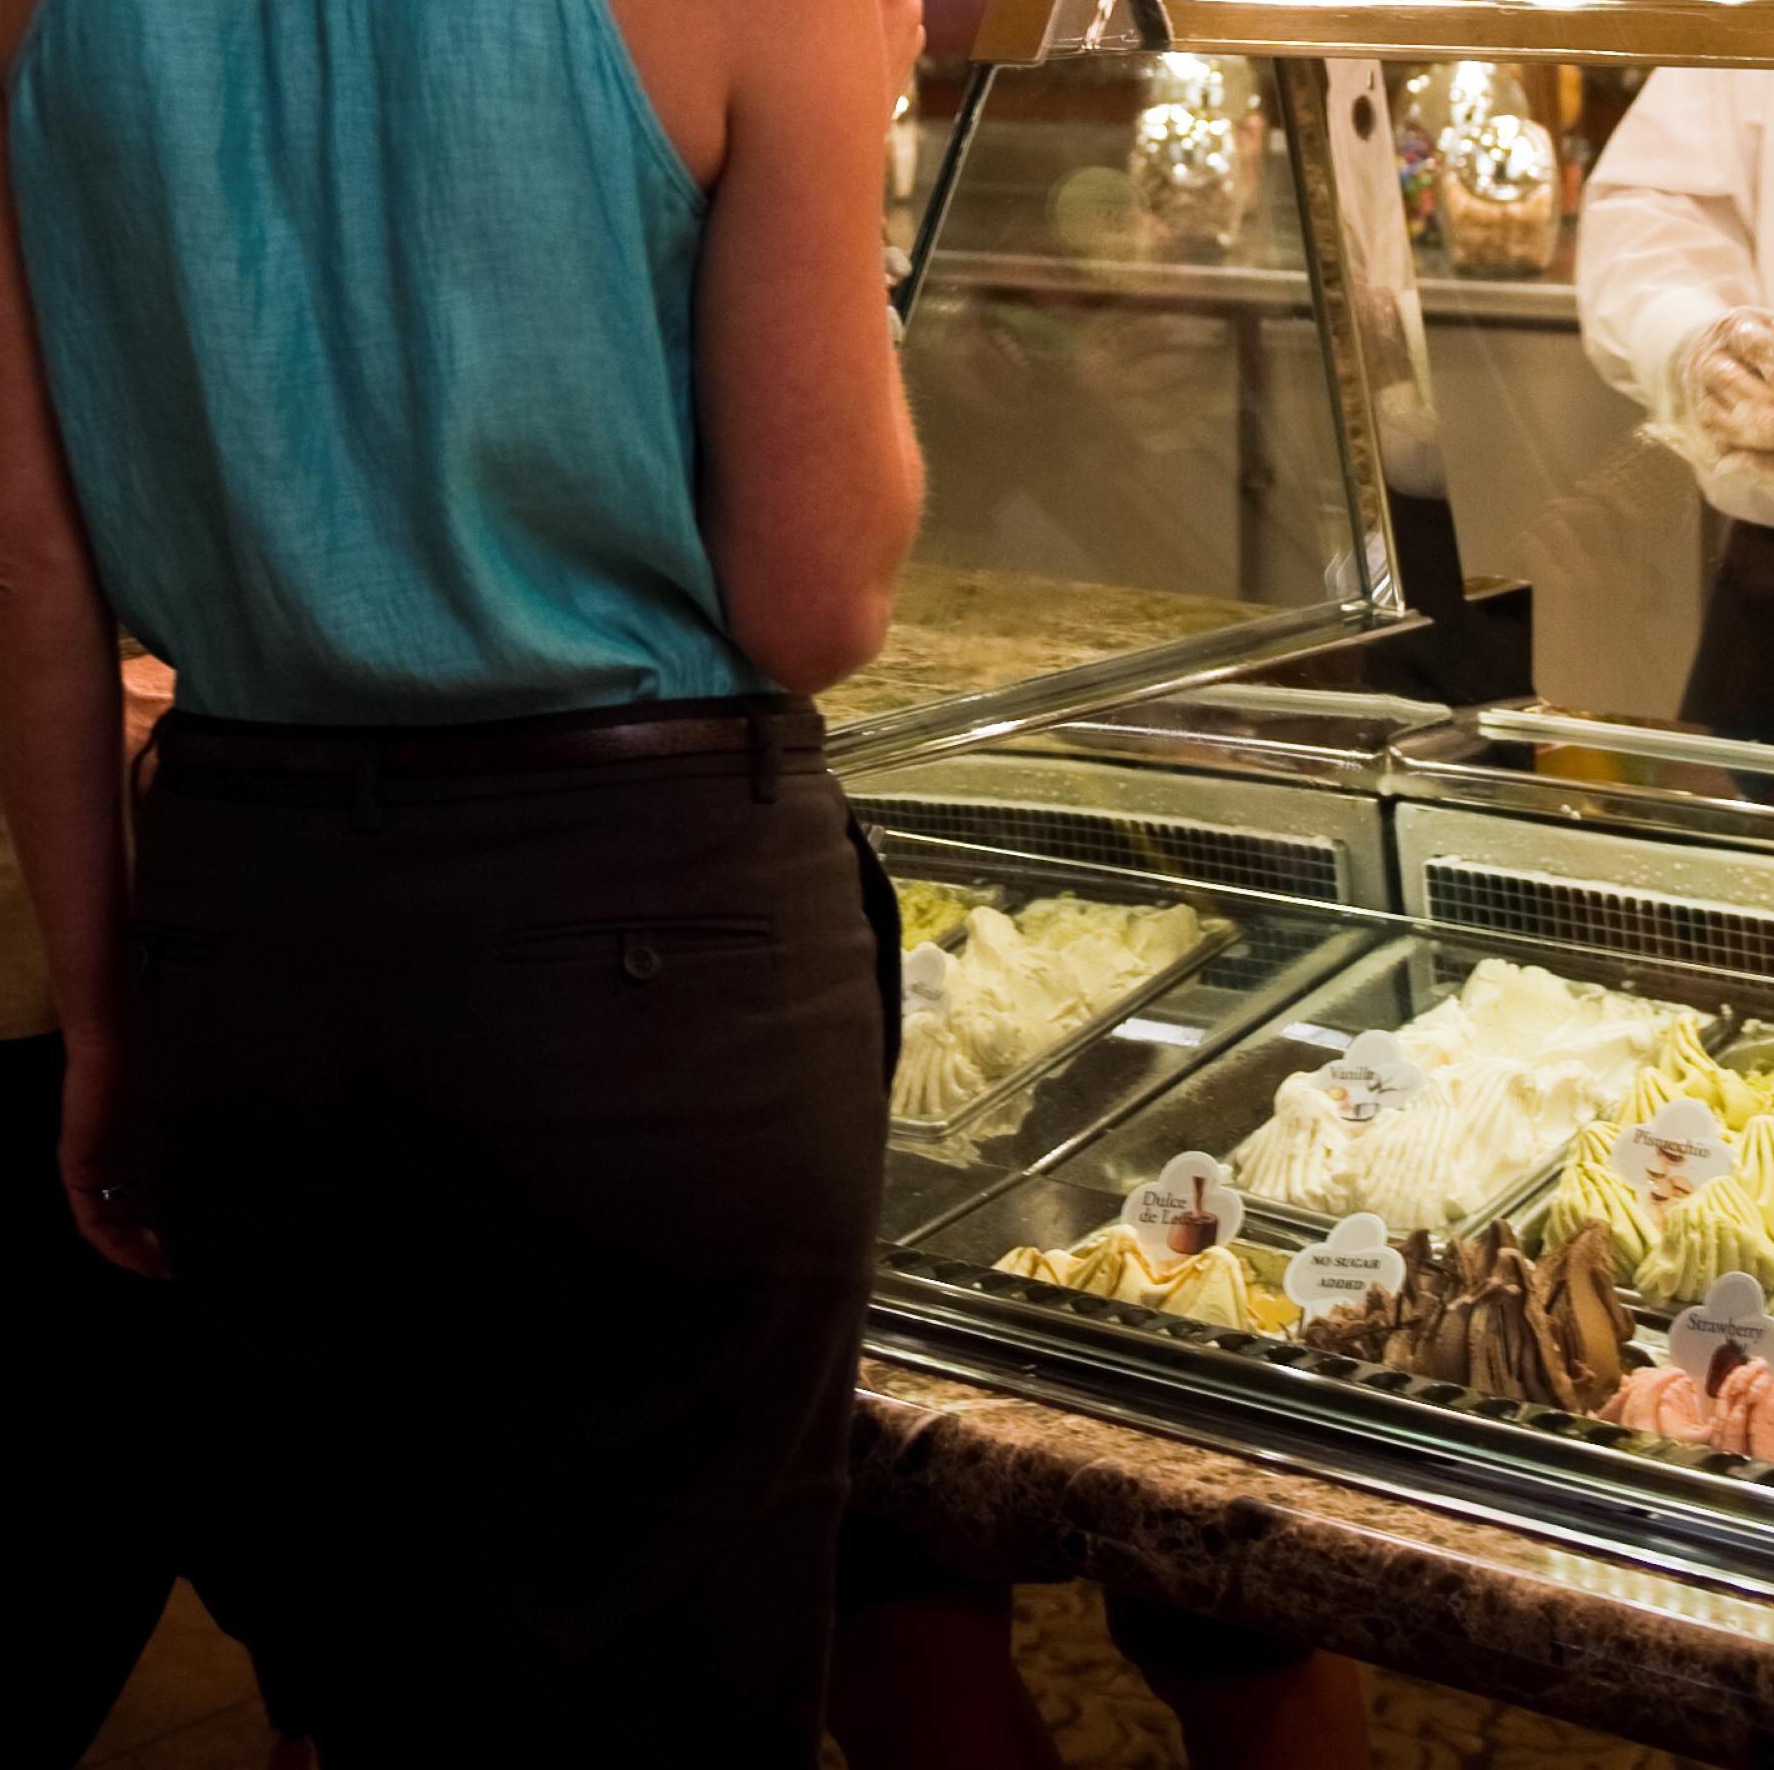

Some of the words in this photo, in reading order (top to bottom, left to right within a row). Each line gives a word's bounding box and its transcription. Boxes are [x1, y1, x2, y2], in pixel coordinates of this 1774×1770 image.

[1142, 1190, 1188, 1209] Dulce
[1138, 1207, 1158, 1224] de
[1311, 1255, 1331, 1266] NO
[1332, 1256, 1381, 1269] SUGAR
[1317, 1276, 1367, 1290] ADDED
[1687, 1313, 1764, 1345] Strawberry
